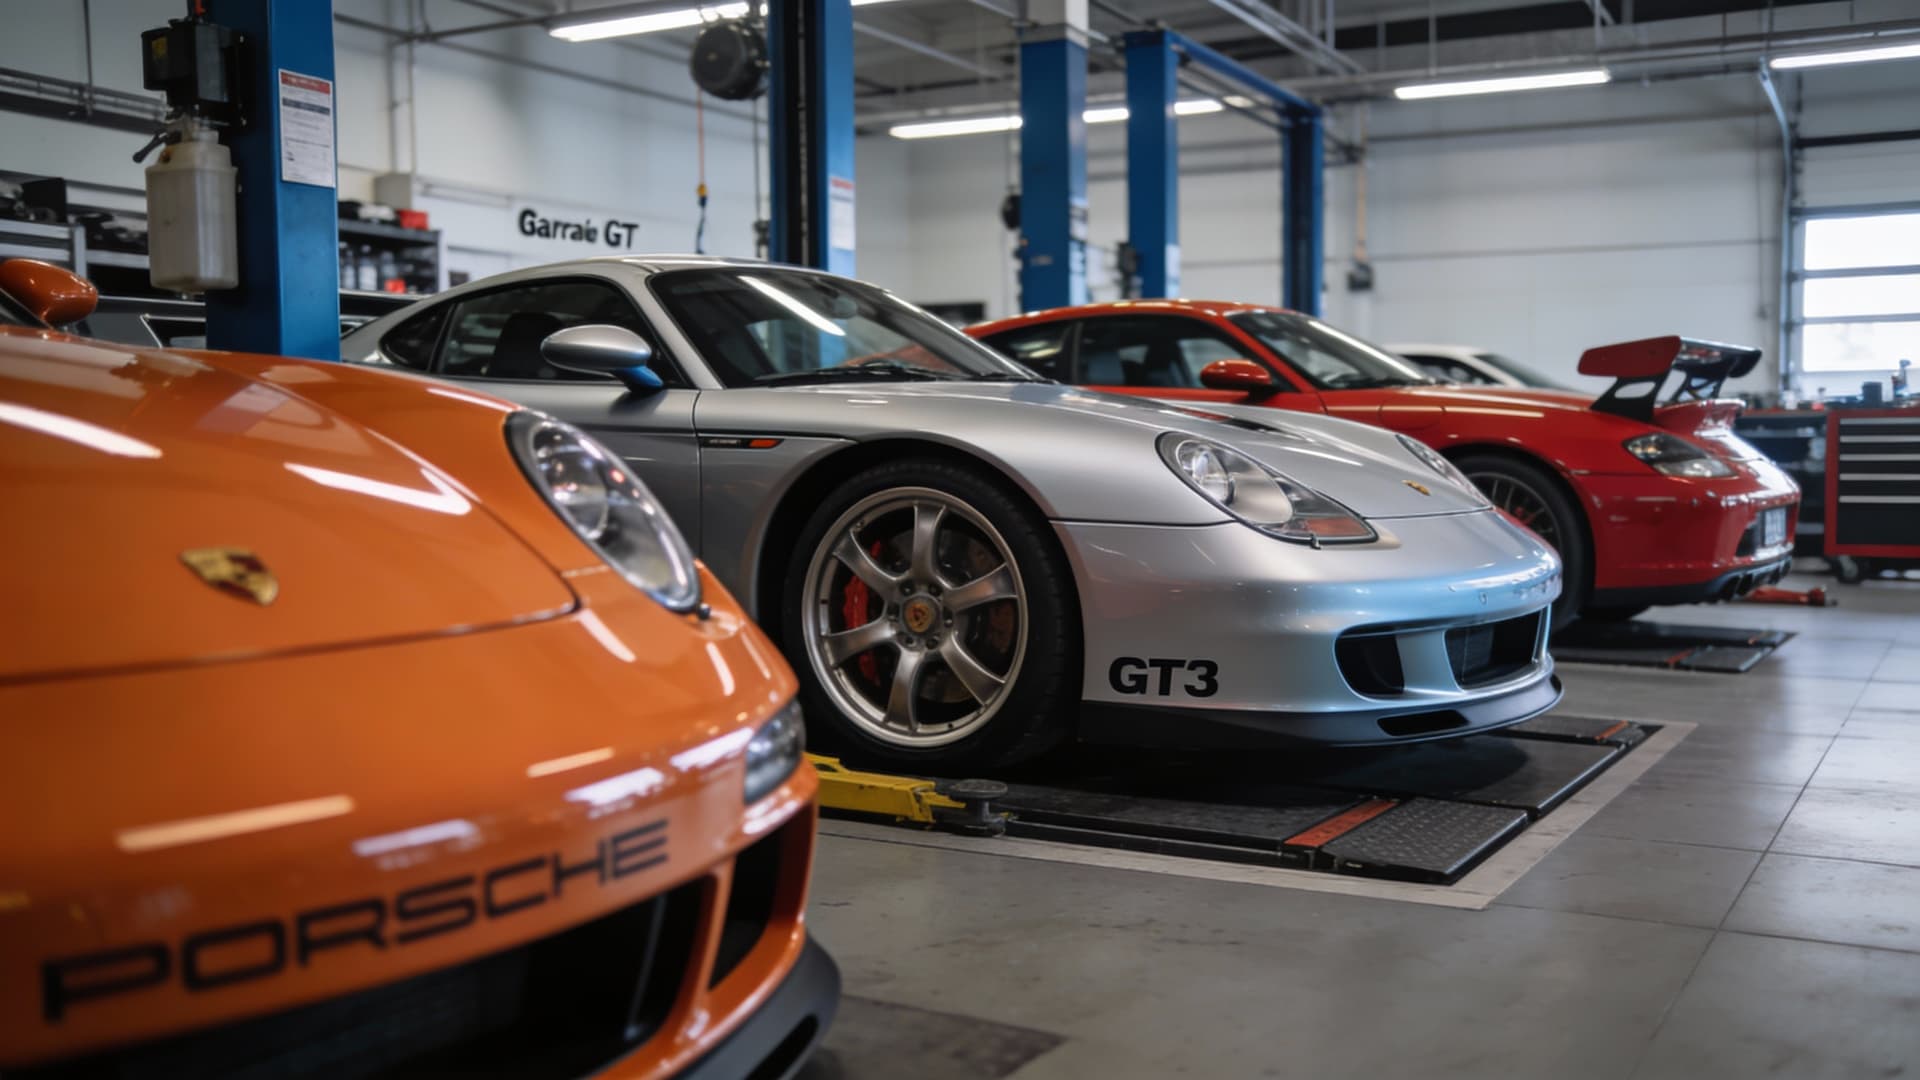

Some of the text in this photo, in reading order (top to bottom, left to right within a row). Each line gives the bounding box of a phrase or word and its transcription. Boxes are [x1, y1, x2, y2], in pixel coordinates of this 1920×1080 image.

[604, 219, 640, 249] GT
[1109, 656, 1219, 698] GT3
[41, 819, 670, 1024] PORSCHE
